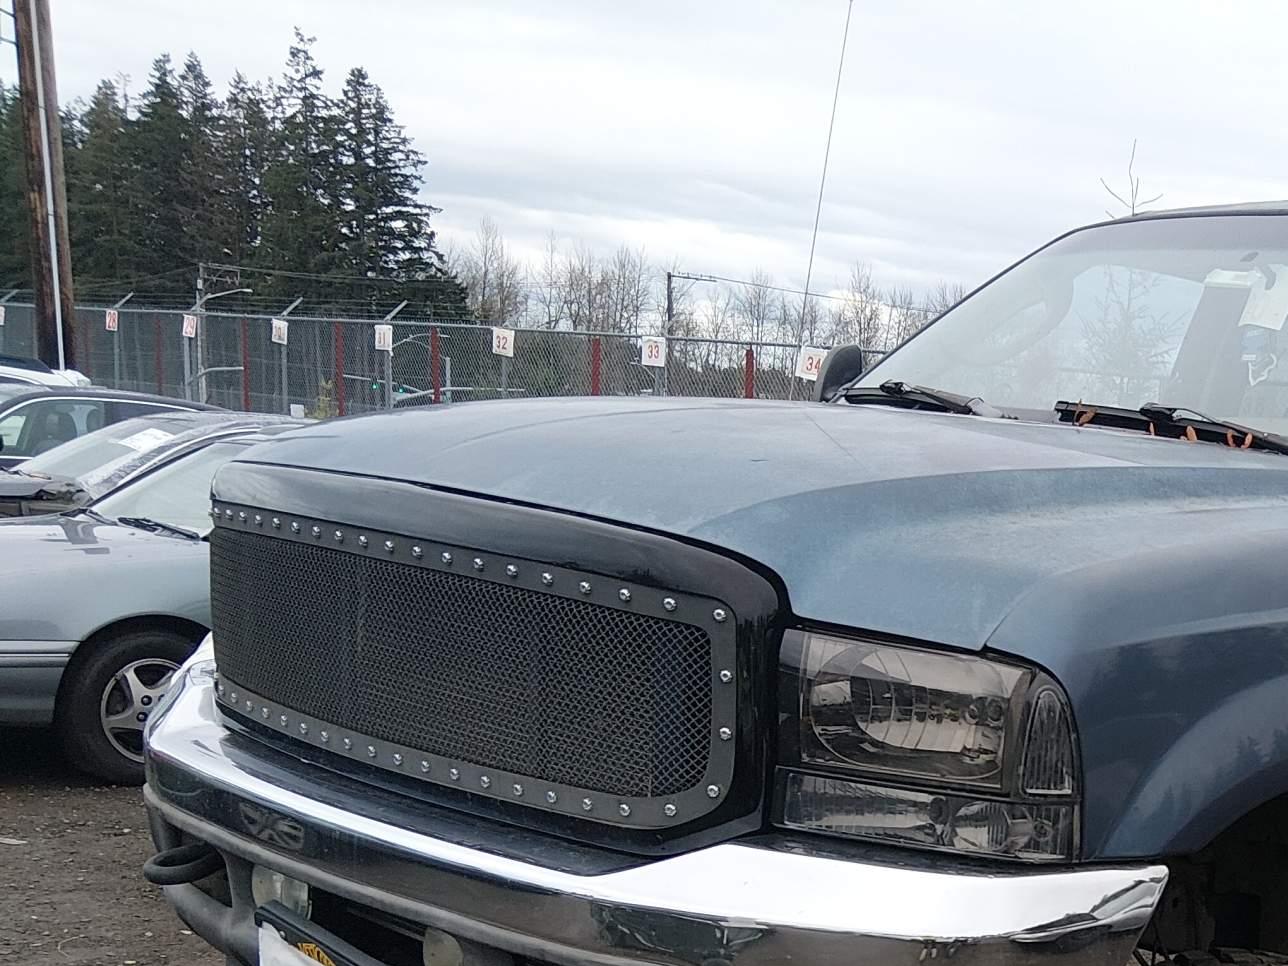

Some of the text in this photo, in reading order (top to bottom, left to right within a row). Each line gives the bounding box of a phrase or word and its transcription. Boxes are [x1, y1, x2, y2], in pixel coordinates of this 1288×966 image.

[107, 311, 117, 329] 28
[184, 316, 195, 335] 29
[496, 335, 508, 350] 32
[648, 344, 659, 359] 33
[806, 356, 821, 373] 34
